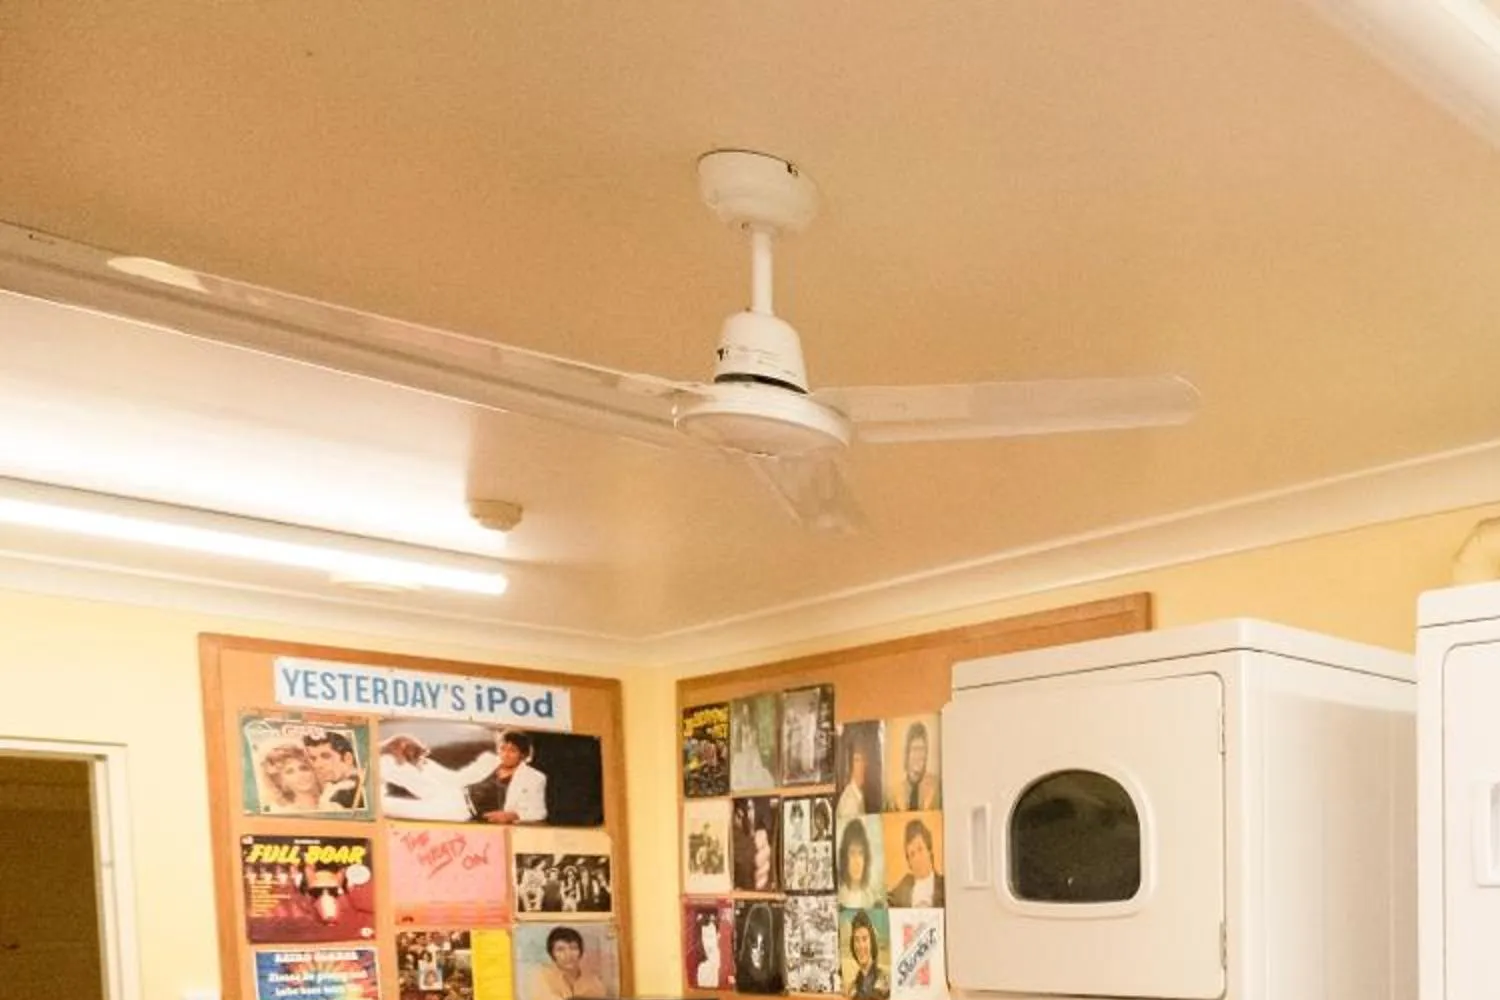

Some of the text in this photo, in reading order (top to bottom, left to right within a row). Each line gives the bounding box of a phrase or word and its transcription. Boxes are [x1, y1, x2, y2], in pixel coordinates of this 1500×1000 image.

[281, 667, 554, 718] YESTERDAY'S iPod
[244, 843, 301, 864] FULL
